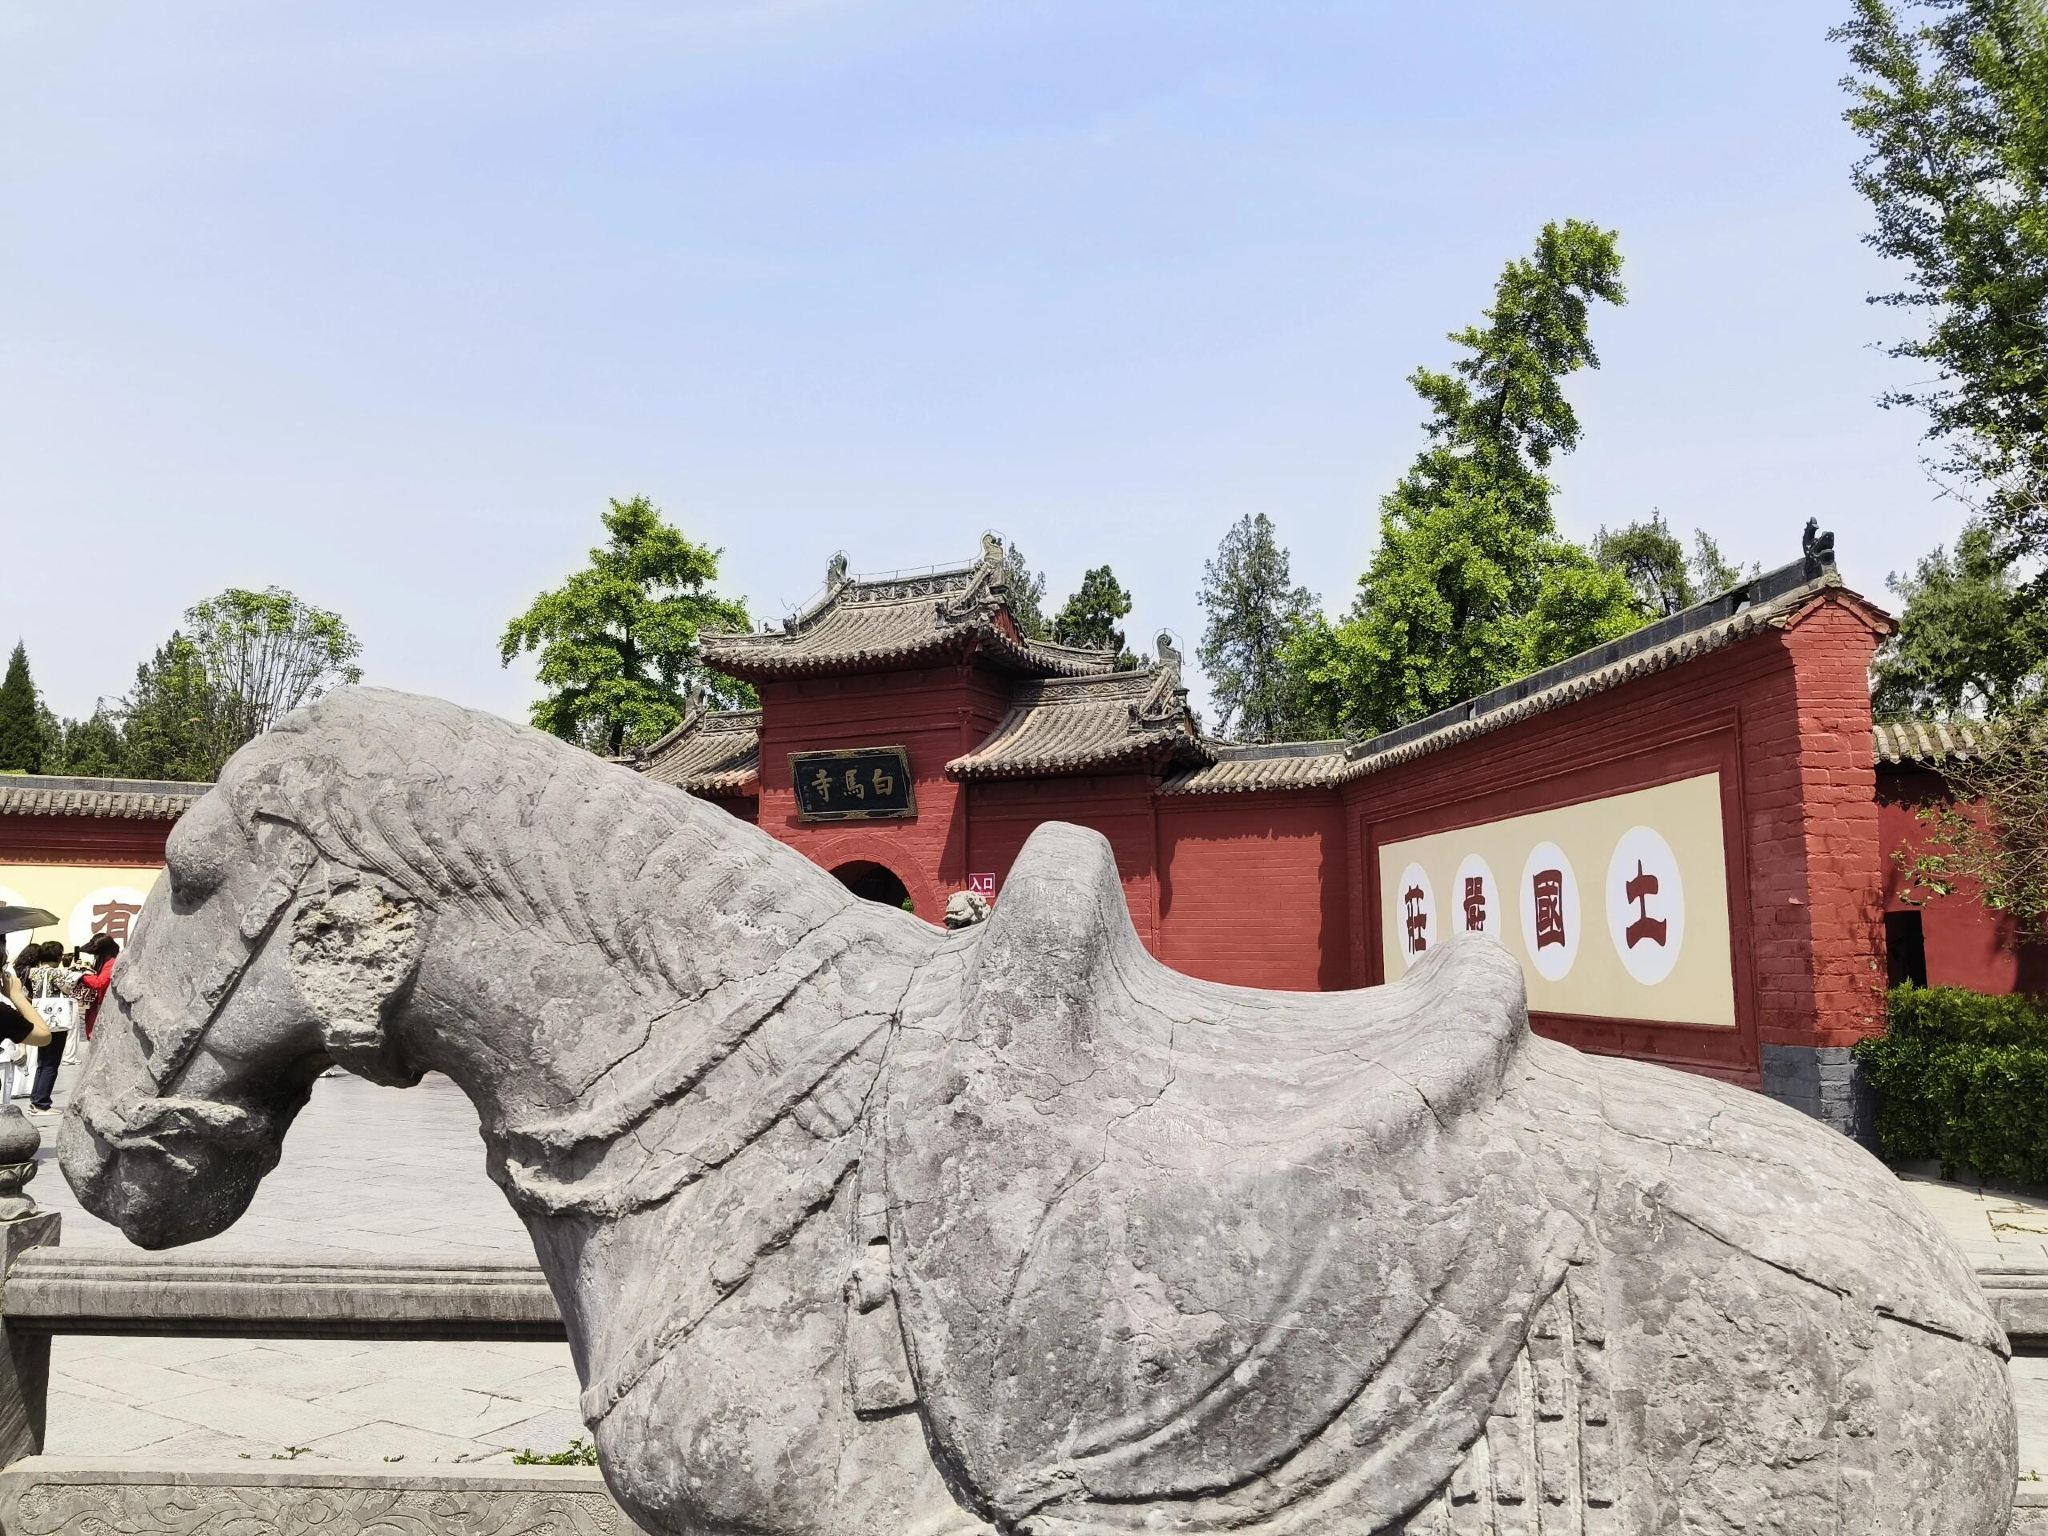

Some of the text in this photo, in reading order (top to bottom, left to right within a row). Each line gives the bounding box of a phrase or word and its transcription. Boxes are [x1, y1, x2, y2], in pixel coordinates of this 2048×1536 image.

[811, 768, 894, 803] 白馬寺
[970, 876, 993, 890] 入口
[91, 899, 142, 947] 有
